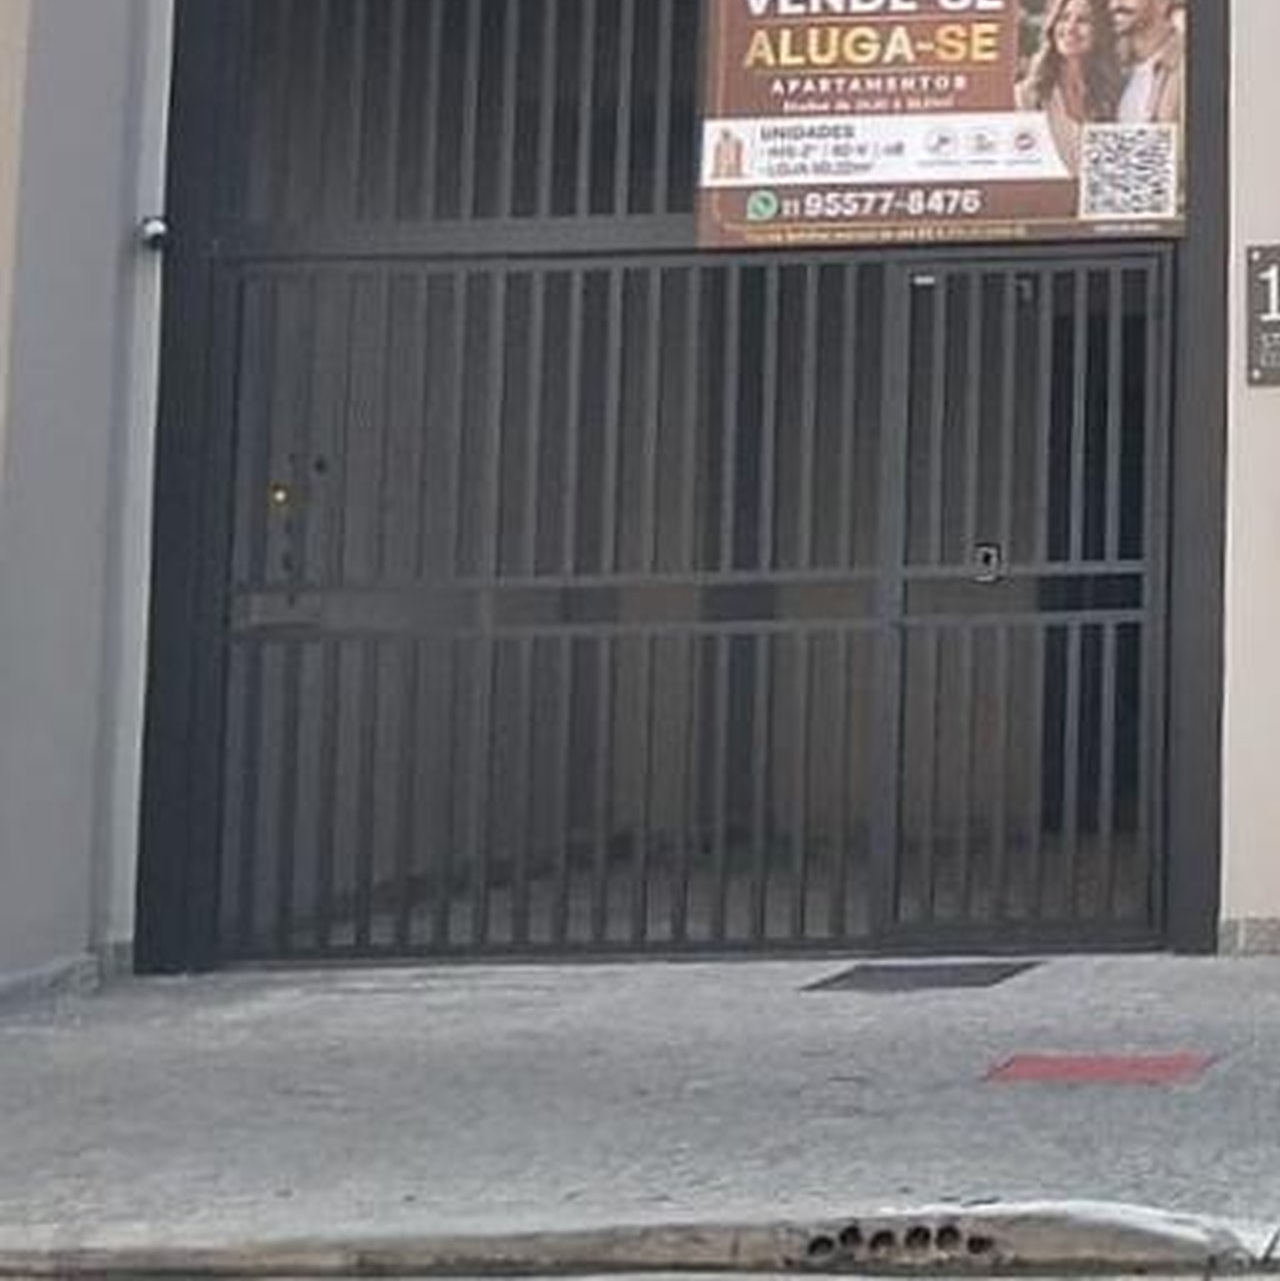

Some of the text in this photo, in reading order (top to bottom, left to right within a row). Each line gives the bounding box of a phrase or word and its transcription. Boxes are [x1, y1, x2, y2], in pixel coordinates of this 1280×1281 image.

[744, 22, 1000, 68] ALUGA-SE
[771, 75, 967, 95] APARTAMENTOS
[760, 124, 855, 141] UNIDADES
[803, 189, 983, 217] 95577-8476
